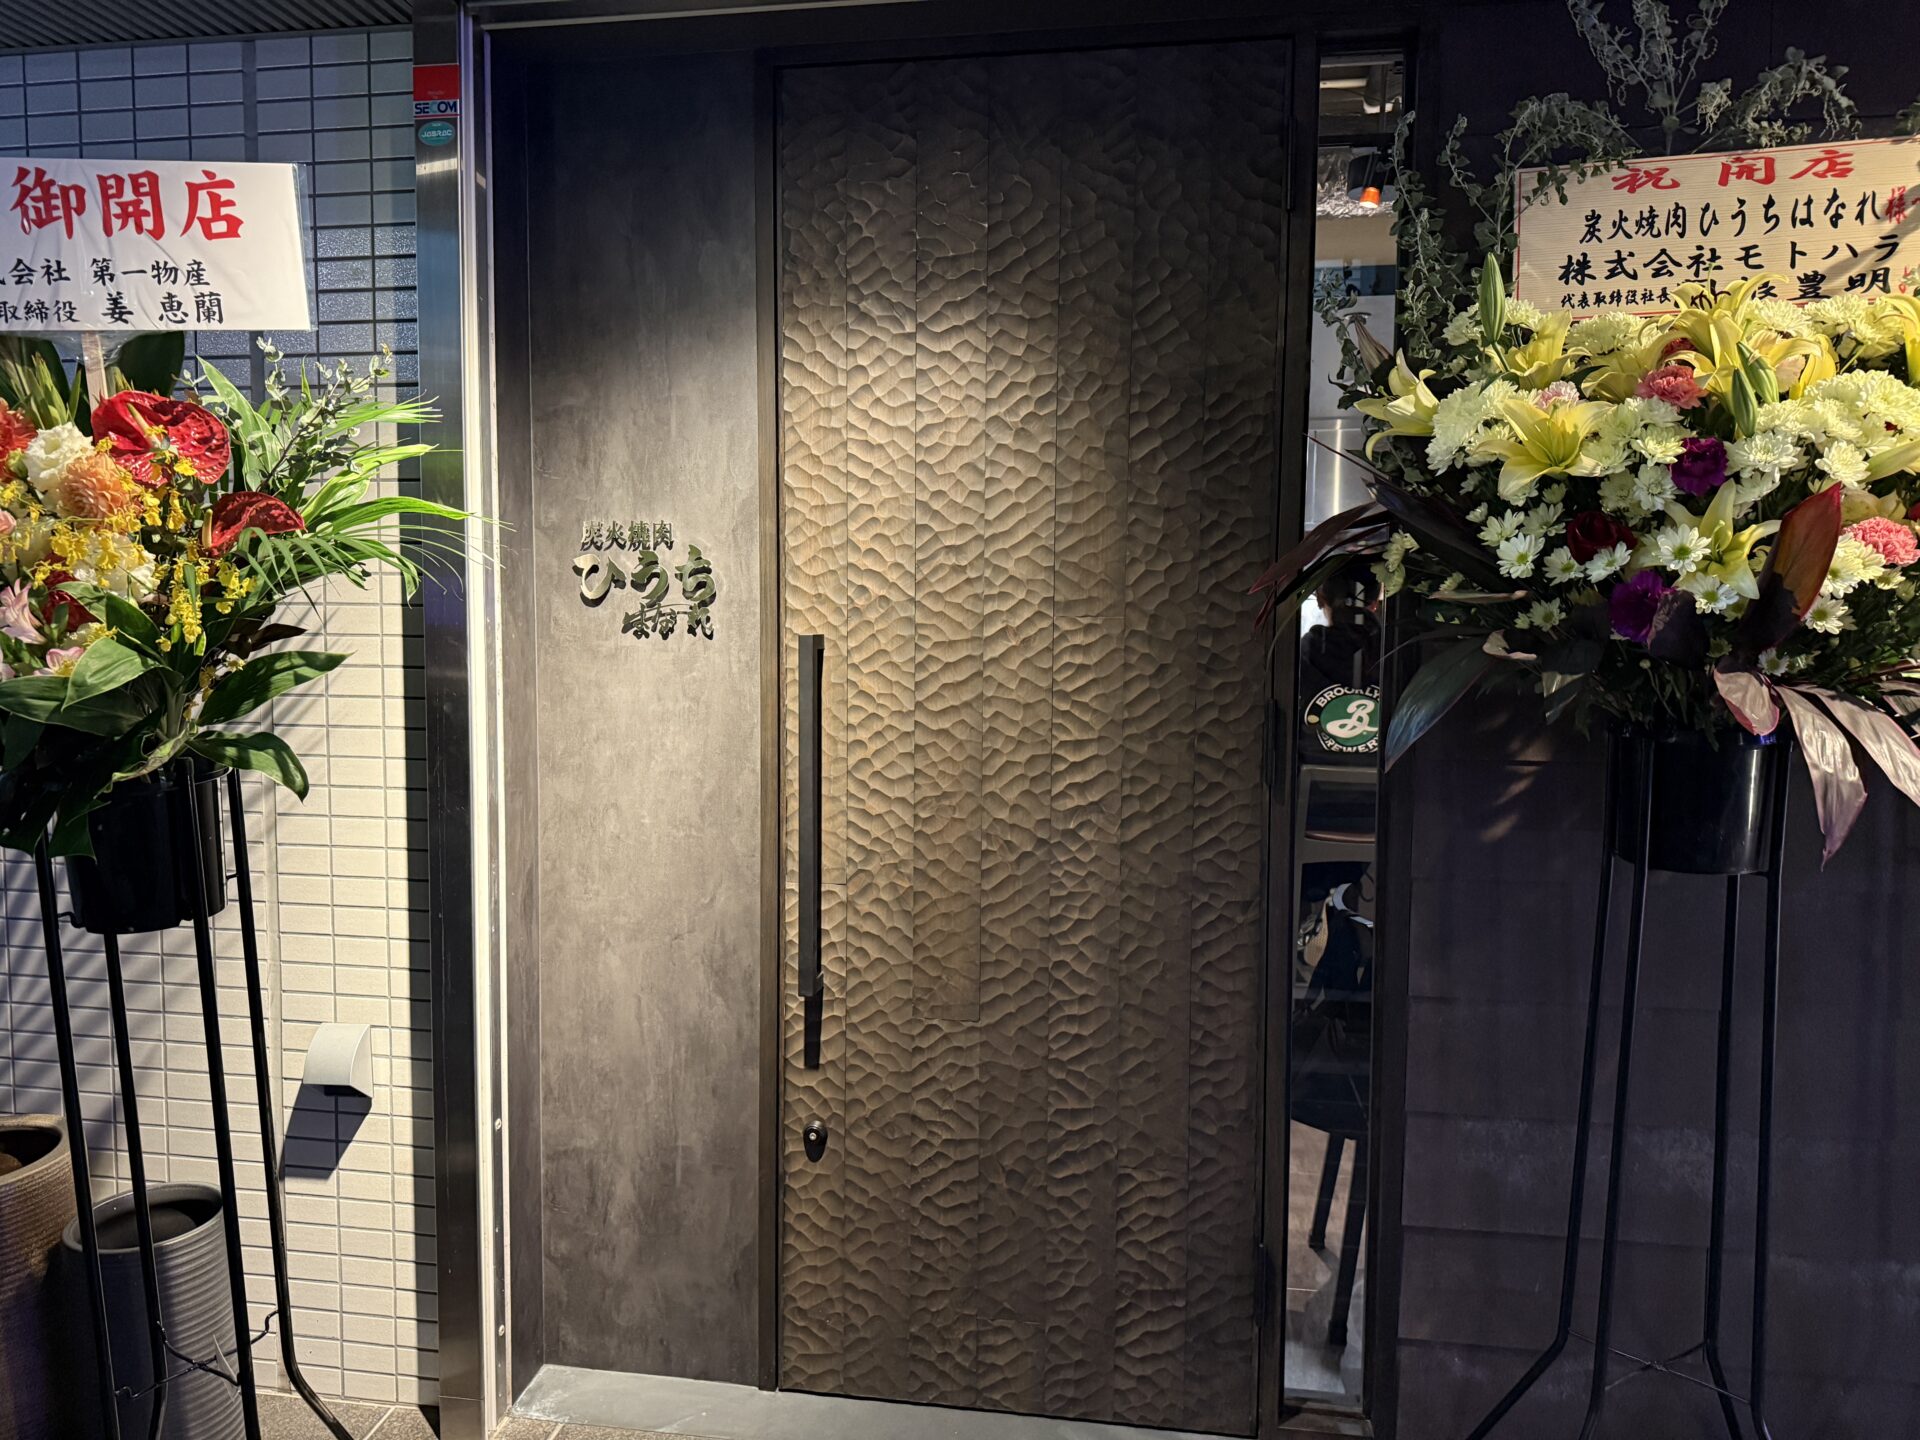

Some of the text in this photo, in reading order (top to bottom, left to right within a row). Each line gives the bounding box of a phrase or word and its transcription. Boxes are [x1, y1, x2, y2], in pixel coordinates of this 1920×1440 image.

[415, 101, 458, 115] SECOM
[0, 258, 211, 286] 会社 第一物産
[1561, 286, 1672, 310] 代表取締役社長
[0, 299, 80, 323] 取締役
[580, 520, 674, 551] 炭火焼肉
[572, 544, 717, 607] ひうち
[1315, 686, 1380, 708] BROOLY
[1320, 732, 1379, 753] REWER
